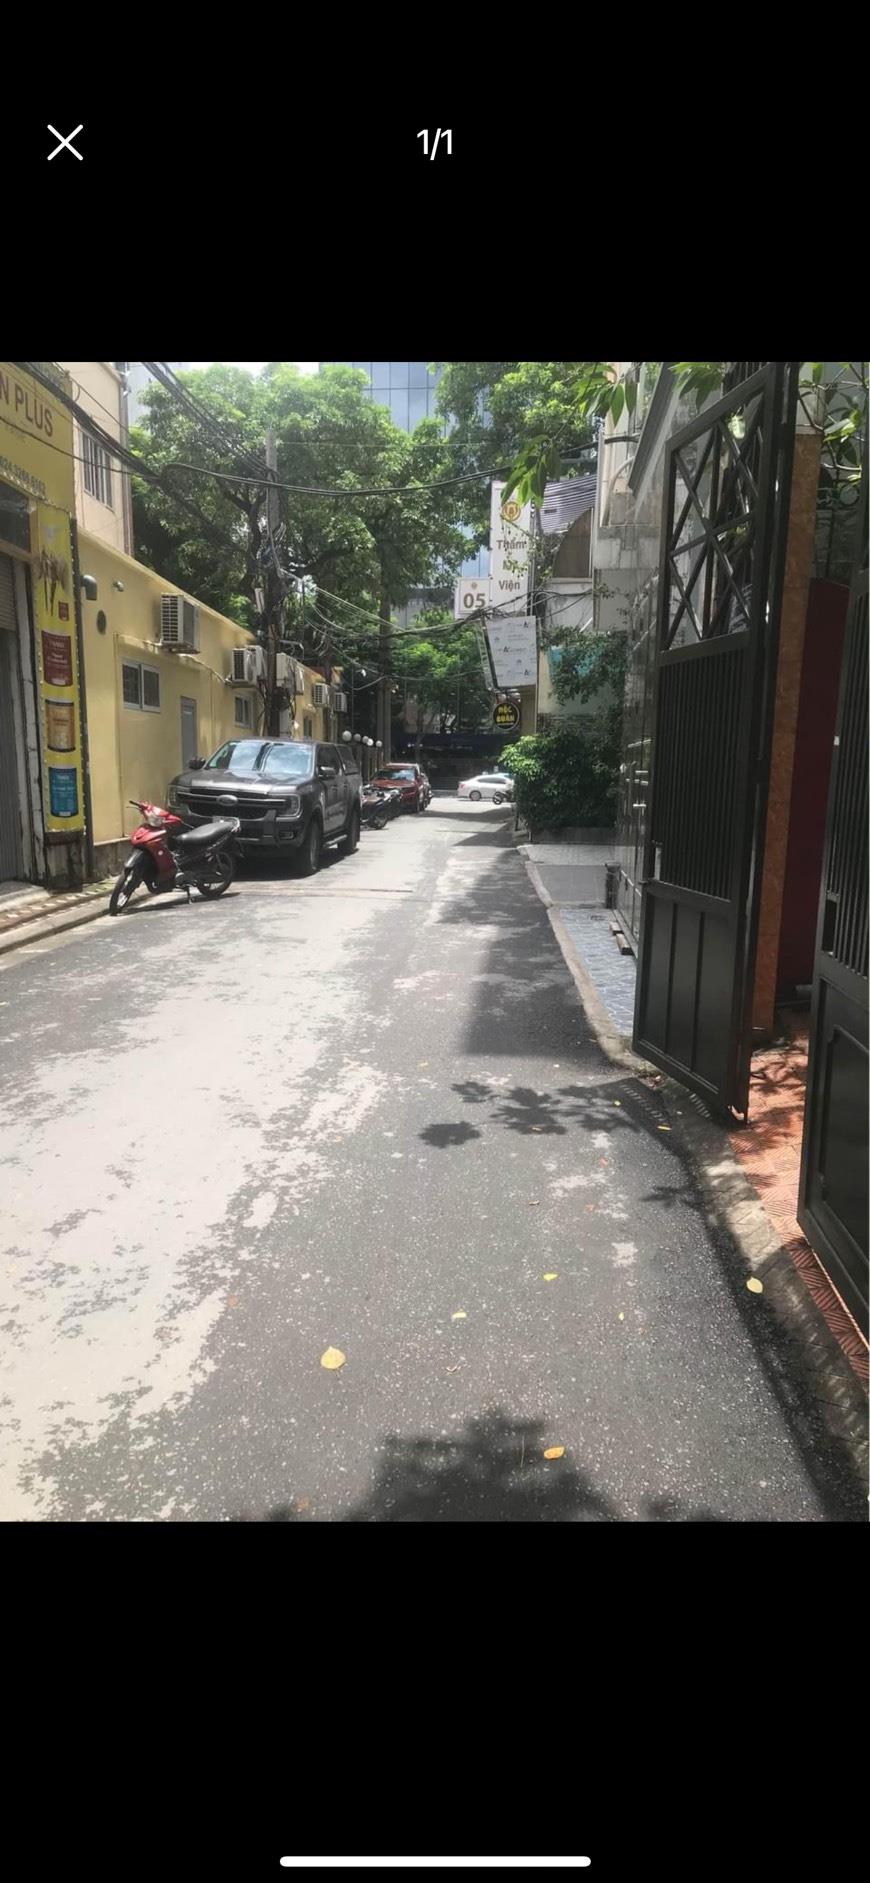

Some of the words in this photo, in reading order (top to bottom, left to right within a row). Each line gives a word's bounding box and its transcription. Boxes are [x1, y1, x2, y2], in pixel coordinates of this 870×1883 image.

[14, 382, 54, 438] PLUS
[498, 580, 521, 592] Viện
[463, 592, 486, 609] 05
